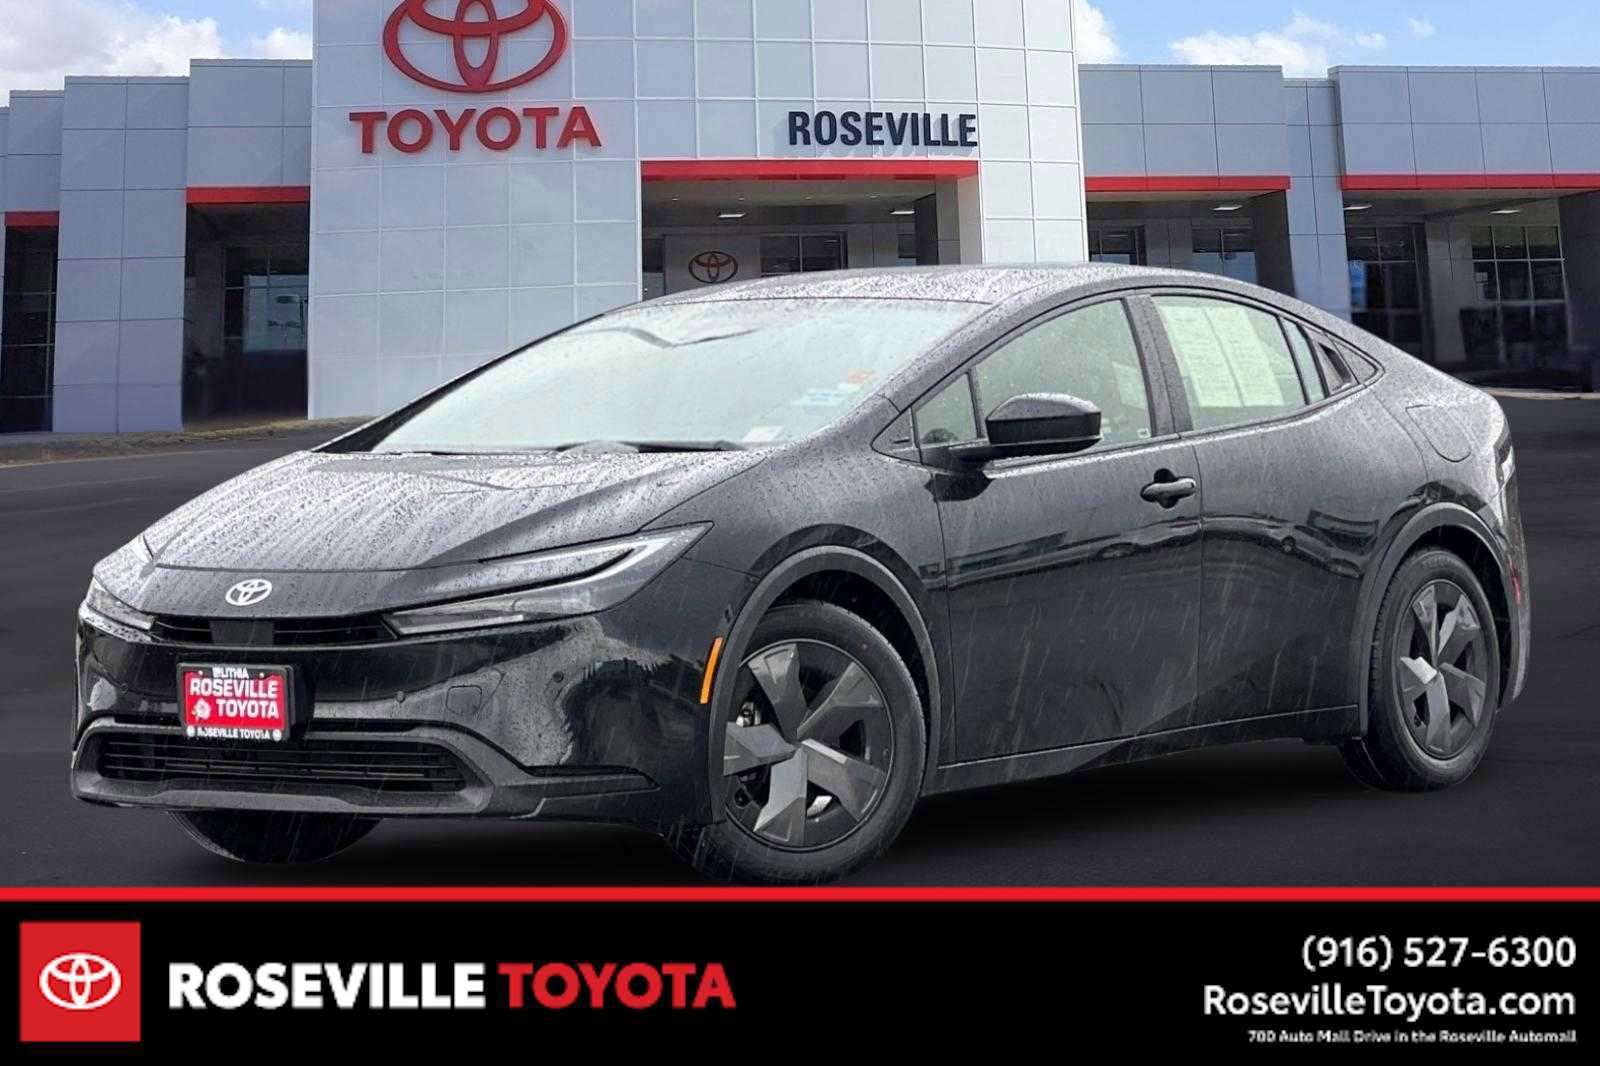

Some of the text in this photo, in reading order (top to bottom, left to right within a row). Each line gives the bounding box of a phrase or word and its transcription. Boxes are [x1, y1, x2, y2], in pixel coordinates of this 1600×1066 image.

[350, 106, 602, 154] TOYOTA
[788, 111, 979, 147] ROSEVILLE
[189, 678, 279, 698] ROSEVILLE
[215, 698, 280, 719] TOYOTA
[197, 727, 271, 740] ROSEVILLE TOYOTA
